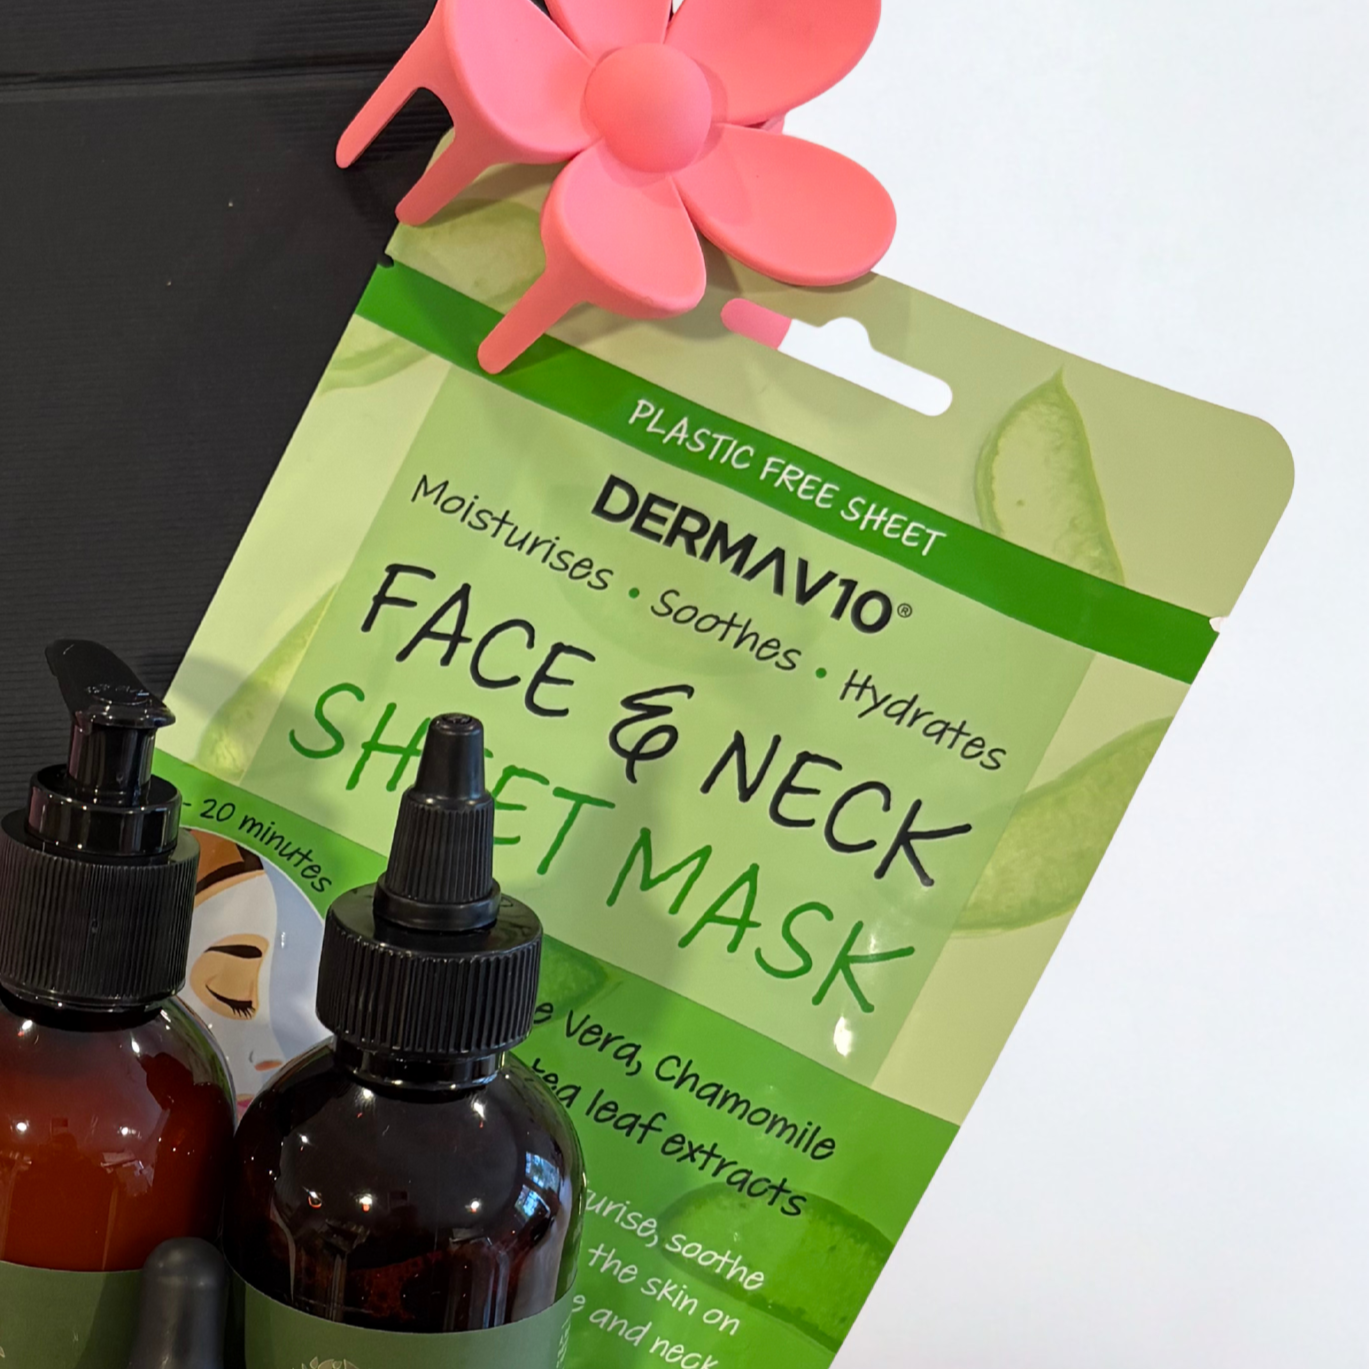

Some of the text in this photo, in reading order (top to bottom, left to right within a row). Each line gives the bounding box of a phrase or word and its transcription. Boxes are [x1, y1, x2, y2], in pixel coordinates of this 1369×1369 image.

[628, 399, 947, 558] PLASTIC FREE SHEET
[411, 473, 1009, 773] Moisturises Soothes Hydrates
[361, 563, 973, 887] FACE & NECK
[238, 814, 332, 893] minutes
[289, 683, 916, 1014] SHET MASK
[565, 1009, 837, 1162] Vera, Chamomile
[585, 1087, 667, 1145] leaf
[660, 1130, 807, 1218] extracts
[587, 1243, 742, 1338] the skin on
[588, 1308, 652, 1348] and
[664, 1233, 765, 1293] soothe
